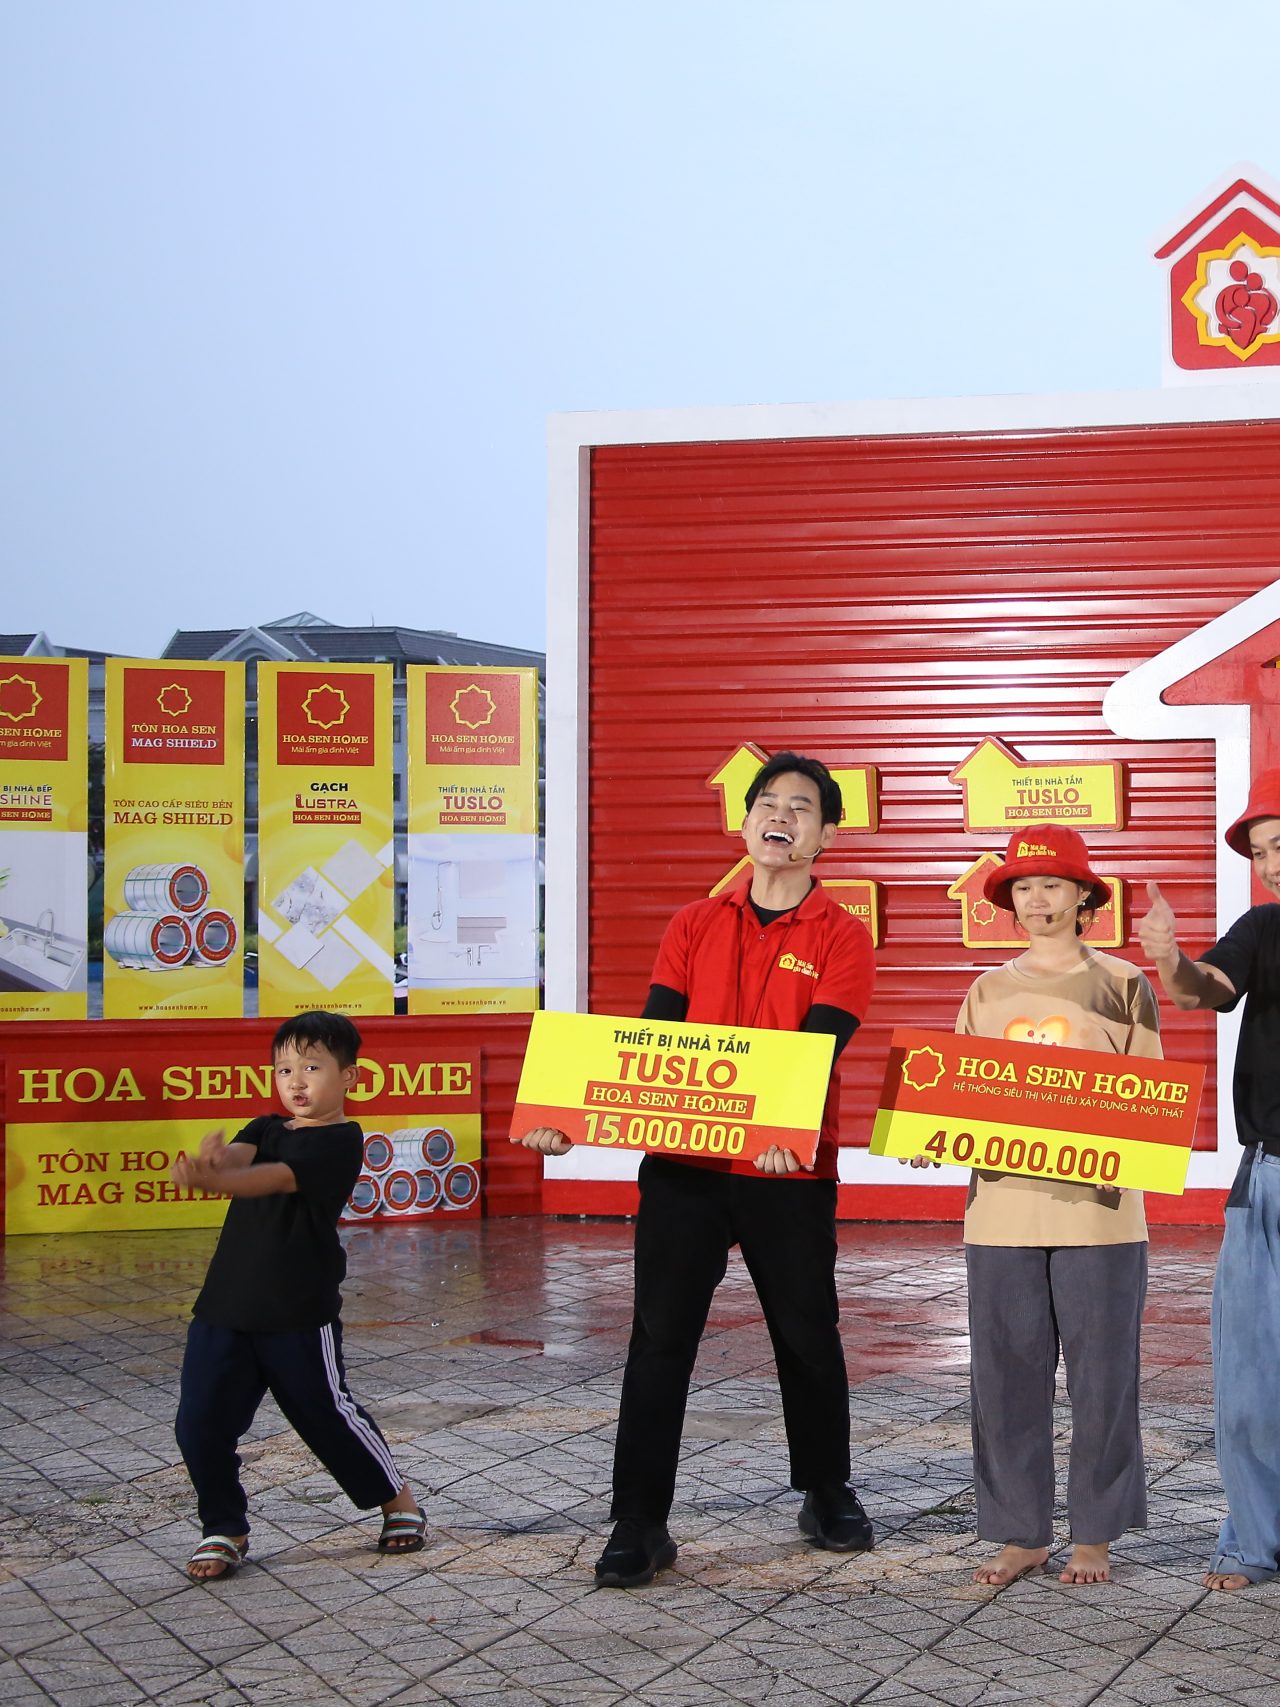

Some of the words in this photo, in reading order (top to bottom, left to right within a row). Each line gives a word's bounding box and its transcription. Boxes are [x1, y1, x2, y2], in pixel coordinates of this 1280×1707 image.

[23, 728, 62, 738] HOME
[131, 723, 159, 733] TÔN
[161, 724, 188, 734] HOA
[191, 725, 217, 735] SEN
[131, 738, 163, 747] MAG
[166, 739, 217, 749] SHIELD
[282, 735, 307, 743] HOA
[308, 735, 331, 744] SEN
[333, 735, 369, 744] HOME
[431, 735, 455, 743] HOA
[456, 735, 478, 743] SEN
[480, 735, 515, 744] HOME
[1012, 776, 1033, 787] THIẾT
[1035, 778, 1043, 788] BỊ
[1045, 776, 1063, 786] NHÀ
[1065, 774, 1083, 785] TẮM
[310, 783, 349, 794] GẠCH
[438, 785, 458, 793] THIẾT
[470, 785, 487, 793] NHÀ
[443, 796, 503, 810] TUSLO
[1016, 788, 1080, 805] TUSLO
[113, 799, 135, 807] TÔN
[138, 800, 159, 808] CAO
[22, 811, 51, 819] HOME
[333, 814, 361, 822] HOME
[1008, 808, 1031, 817] HOA
[1032, 807, 1053, 817] SEN
[1055, 806, 1088, 817] HOME
[113, 812, 157, 824] MAG
[162, 812, 233, 825] SHIELD
[479, 814, 506, 823] HOME
[613, 1027, 654, 1047] THIẾT
[657, 1034, 673, 1051] BỊ
[676, 1036, 711, 1051] NHÀ
[717, 1034, 750, 1055] TẮM
[617, 1051, 738, 1089] TUSLO
[18, 1067, 146, 1103] HOA
[162, 1065, 275, 1101] SEN
[345, 1057, 472, 1102] OME
[956, 1056, 1018, 1084] HOA
[1025, 1065, 1087, 1091] SEN
[1091, 1072, 1190, 1104] HOME
[591, 1086, 633, 1105] HOA
[638, 1091, 679, 1108] SEN
[684, 1094, 748, 1114] HOME
[952, 1082, 965, 1093] HỆ
[967, 1082, 1001, 1096] THỐNG
[1003, 1087, 1023, 1098] SIÊU
[1025, 1090, 1039, 1102] THỊ
[1040, 1091, 1058, 1104] VẬT
[1060, 1093, 1078, 1106] LIỆU
[1079, 1096, 1098, 1107] XÂY
[1099, 1100, 1128, 1111] DỰNG
[1130, 1103, 1138, 1113] &
[1140, 1104, 1159, 1116] NỘI
[1161, 1107, 1184, 1119] THẤT
[584, 1112, 746, 1155] 15.000.000
[38, 1148, 110, 1174] TÔN
[925, 1130, 1121, 1182] 40.000.000
[37, 1181, 124, 1207] MAG
